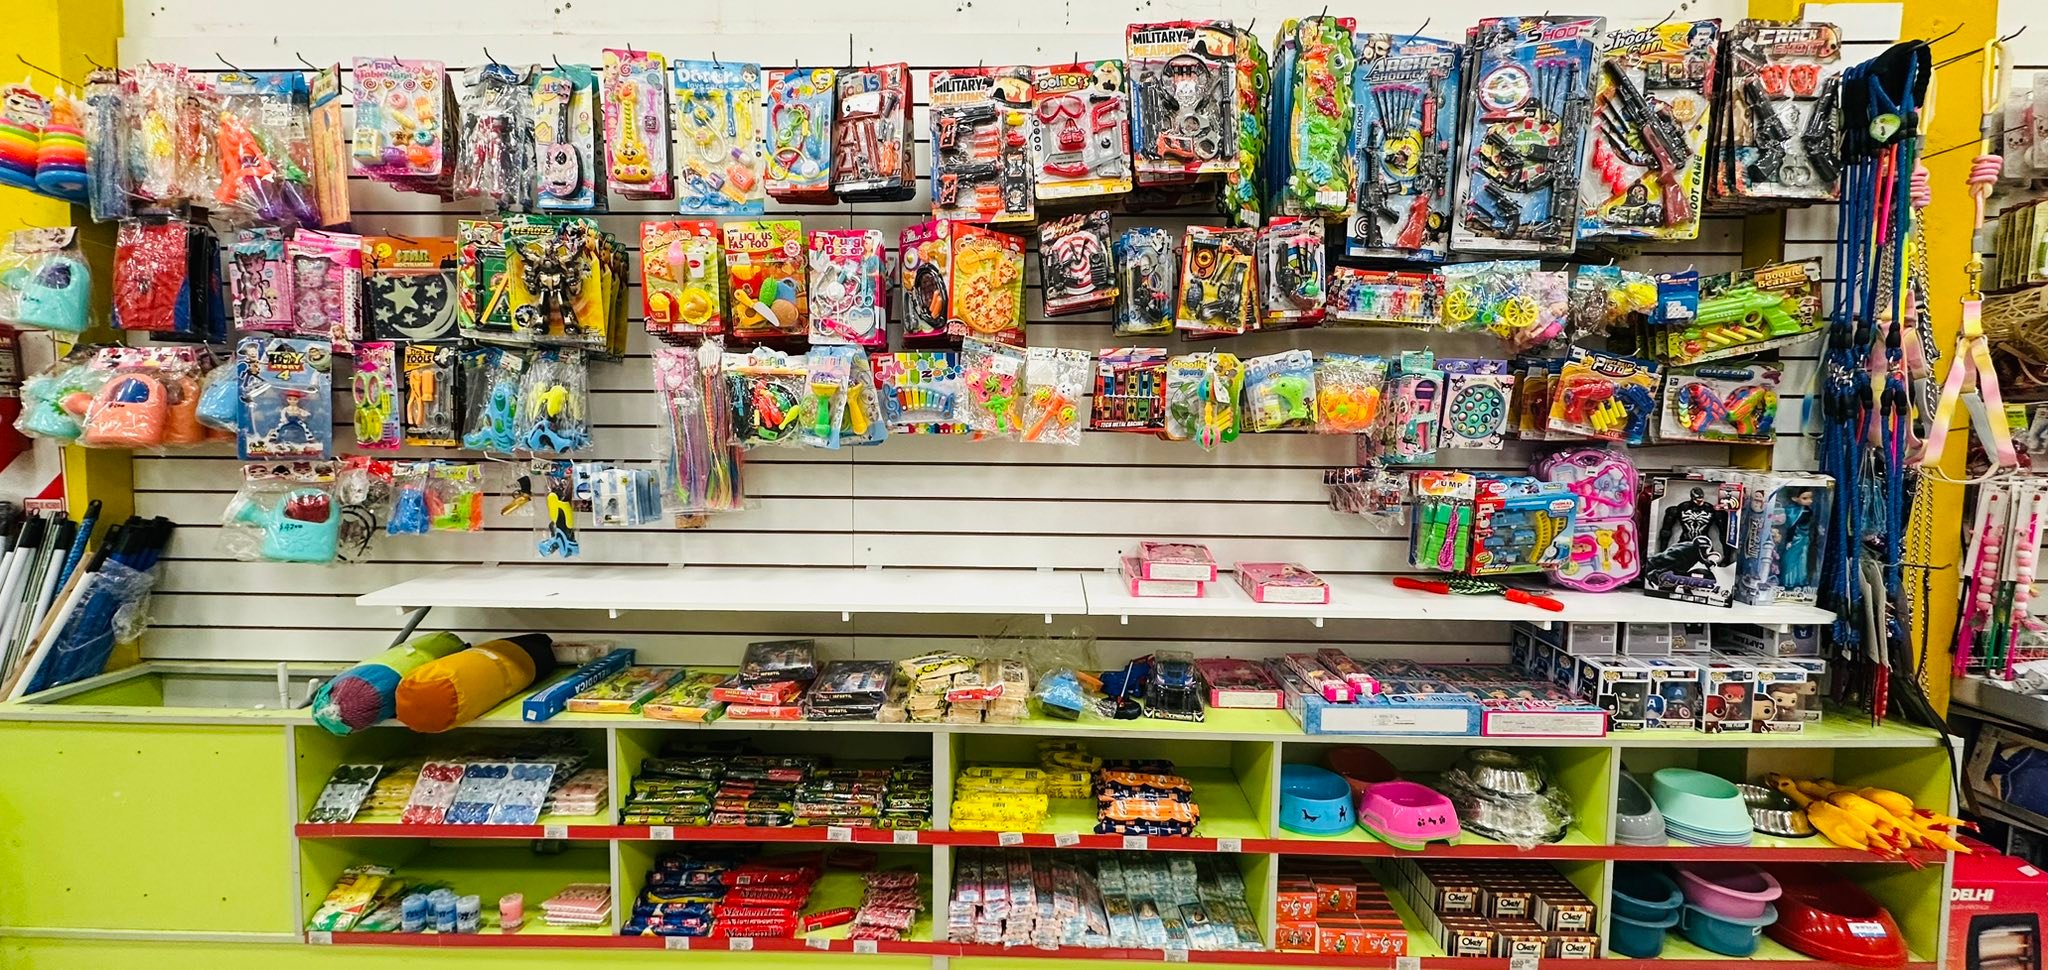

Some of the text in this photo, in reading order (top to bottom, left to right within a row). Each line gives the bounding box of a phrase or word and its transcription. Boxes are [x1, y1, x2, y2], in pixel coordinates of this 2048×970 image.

[1133, 31, 1183, 44] MILITARY
[1134, 44, 1187, 56] WEAPONS
[1374, 55, 1453, 72] ARCHER
[934, 79, 983, 93] MILITARY
[407, 355, 431, 363] TOOLS
[276, 370, 290, 380] 4
[1951, 888, 1994, 902] DELHI
